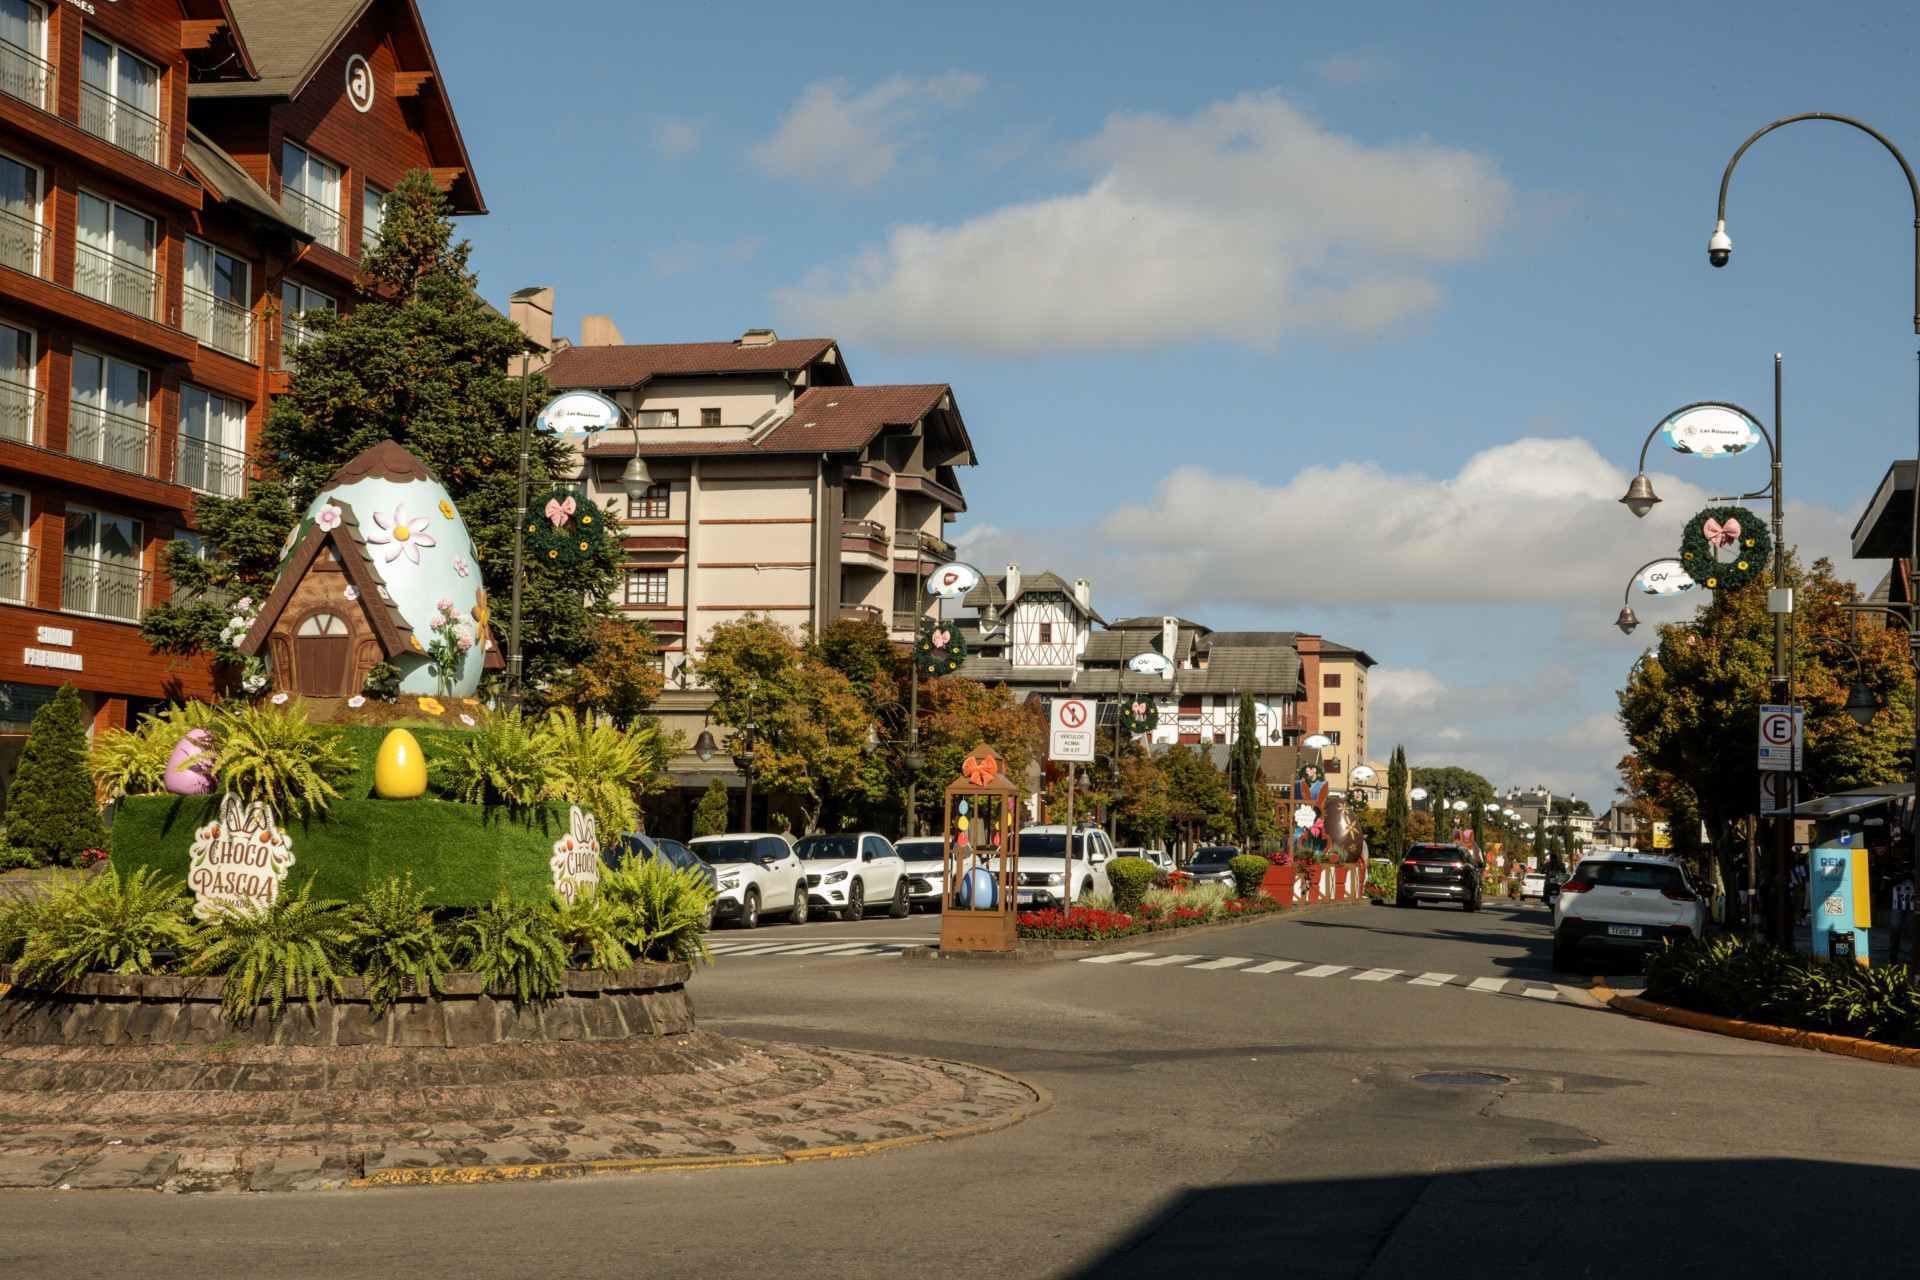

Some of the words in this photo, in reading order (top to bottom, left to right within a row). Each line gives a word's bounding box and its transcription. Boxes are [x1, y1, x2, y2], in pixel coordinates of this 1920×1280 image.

[1773, 719, 1786, 739] E
[208, 839, 269, 868] CHOCO
[567, 852, 595, 876] CHOCO
